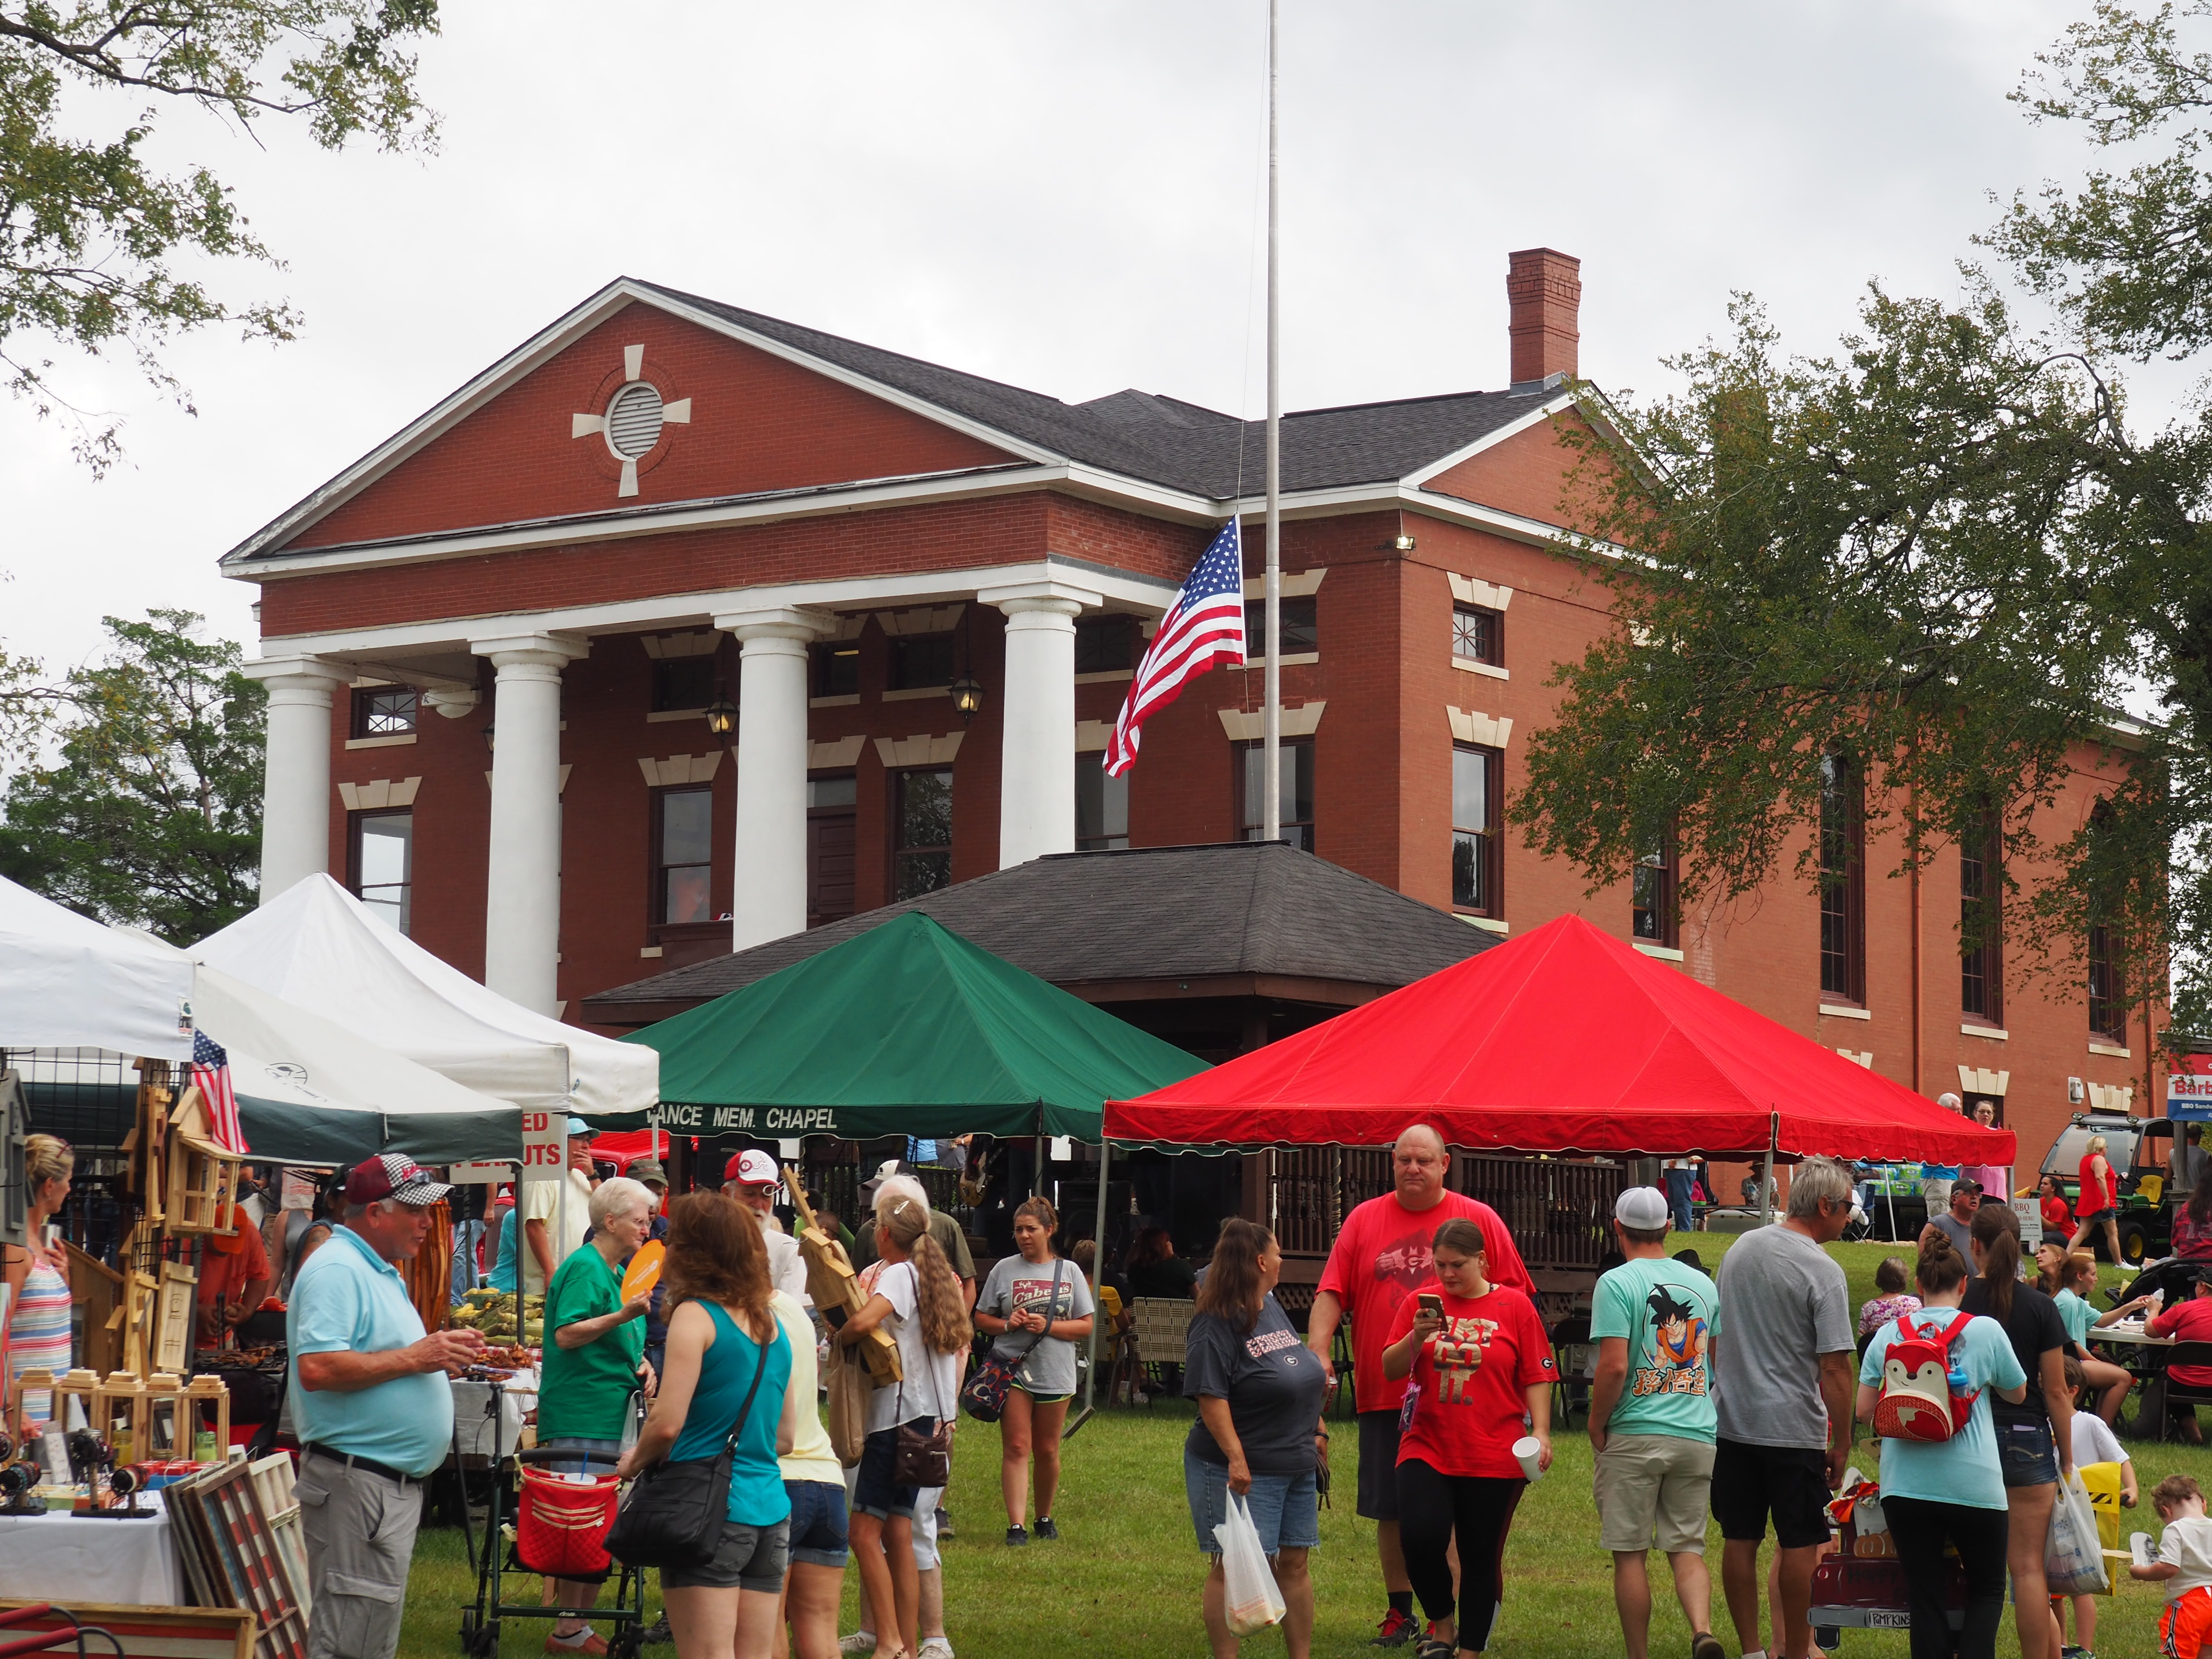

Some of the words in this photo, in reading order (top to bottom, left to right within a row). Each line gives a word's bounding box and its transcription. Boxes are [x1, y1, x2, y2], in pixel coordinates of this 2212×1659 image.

[713, 1106, 756, 1128] MEM.
[766, 1108, 838, 1129] CHAPEL
[2015, 1203, 2030, 1214] BBQ
[1013, 1284, 1070, 1305] Cabe's
[1433, 1340, 1482, 1375] DO
[1541, 1357, 1554, 1370] G
